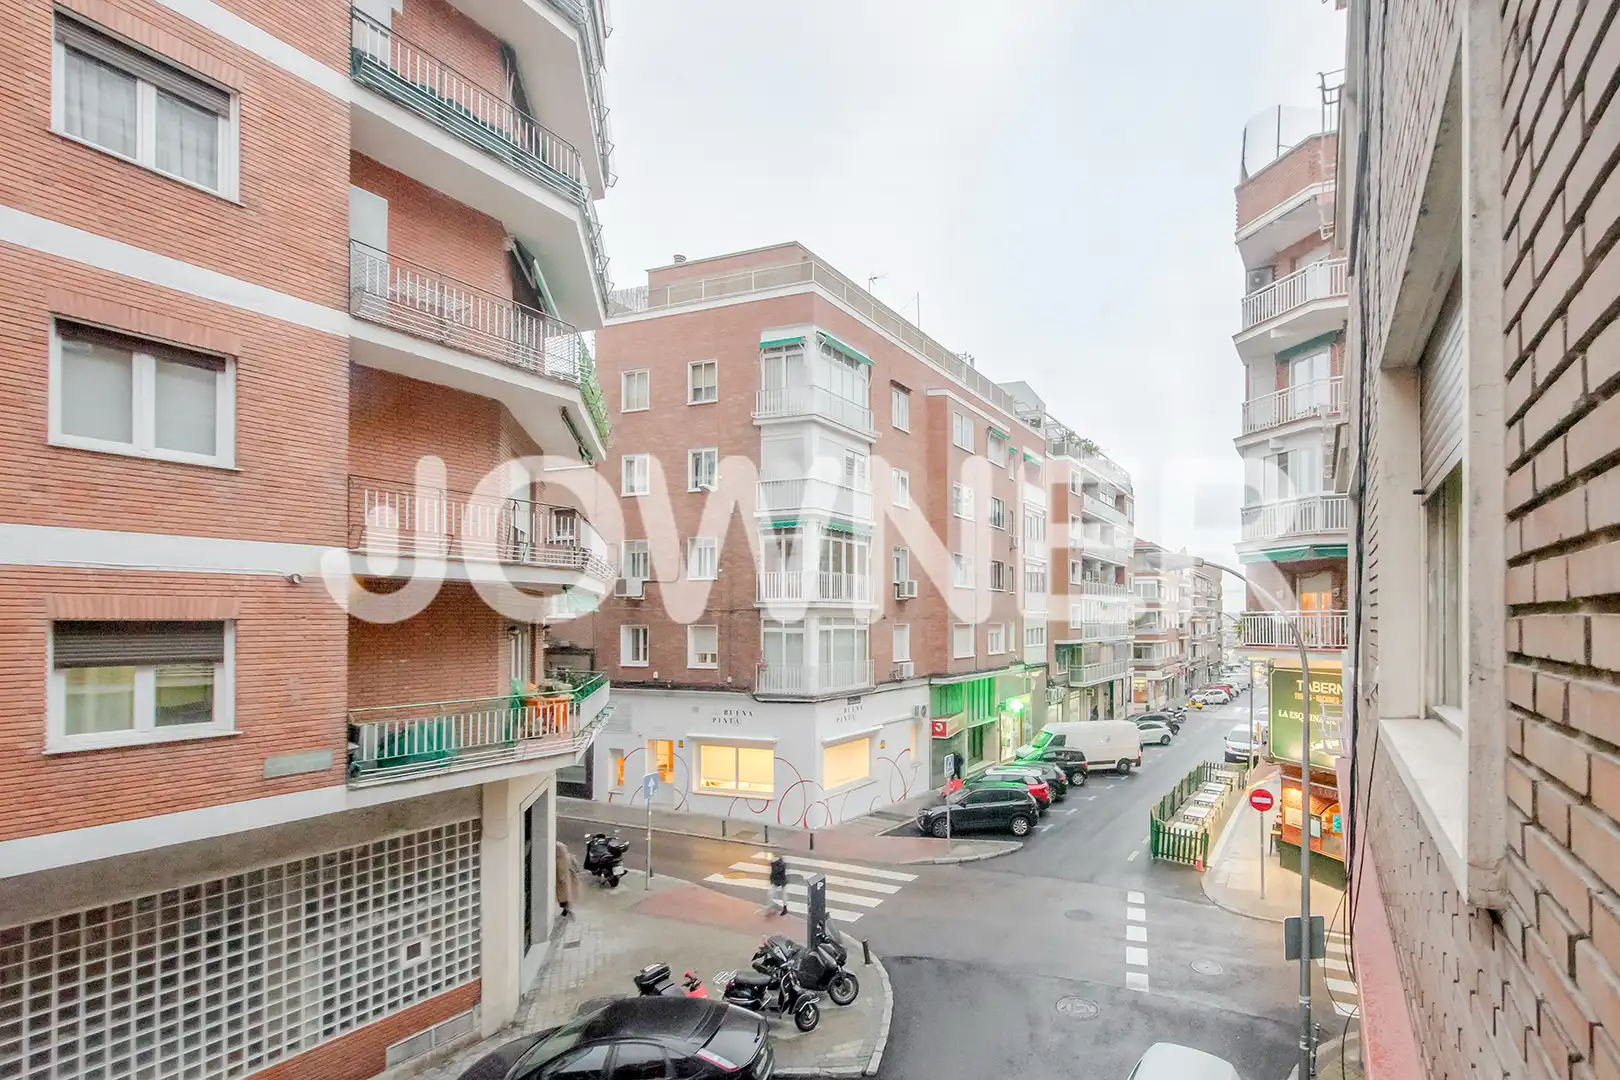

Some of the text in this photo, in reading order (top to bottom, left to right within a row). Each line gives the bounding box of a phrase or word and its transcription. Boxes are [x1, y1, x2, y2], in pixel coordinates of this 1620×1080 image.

[723, 709, 753, 717] BUENA
[1289, 711, 1325, 723] ESQINA
[712, 717, 740, 725] PINTA
[817, 882, 824, 890] P
